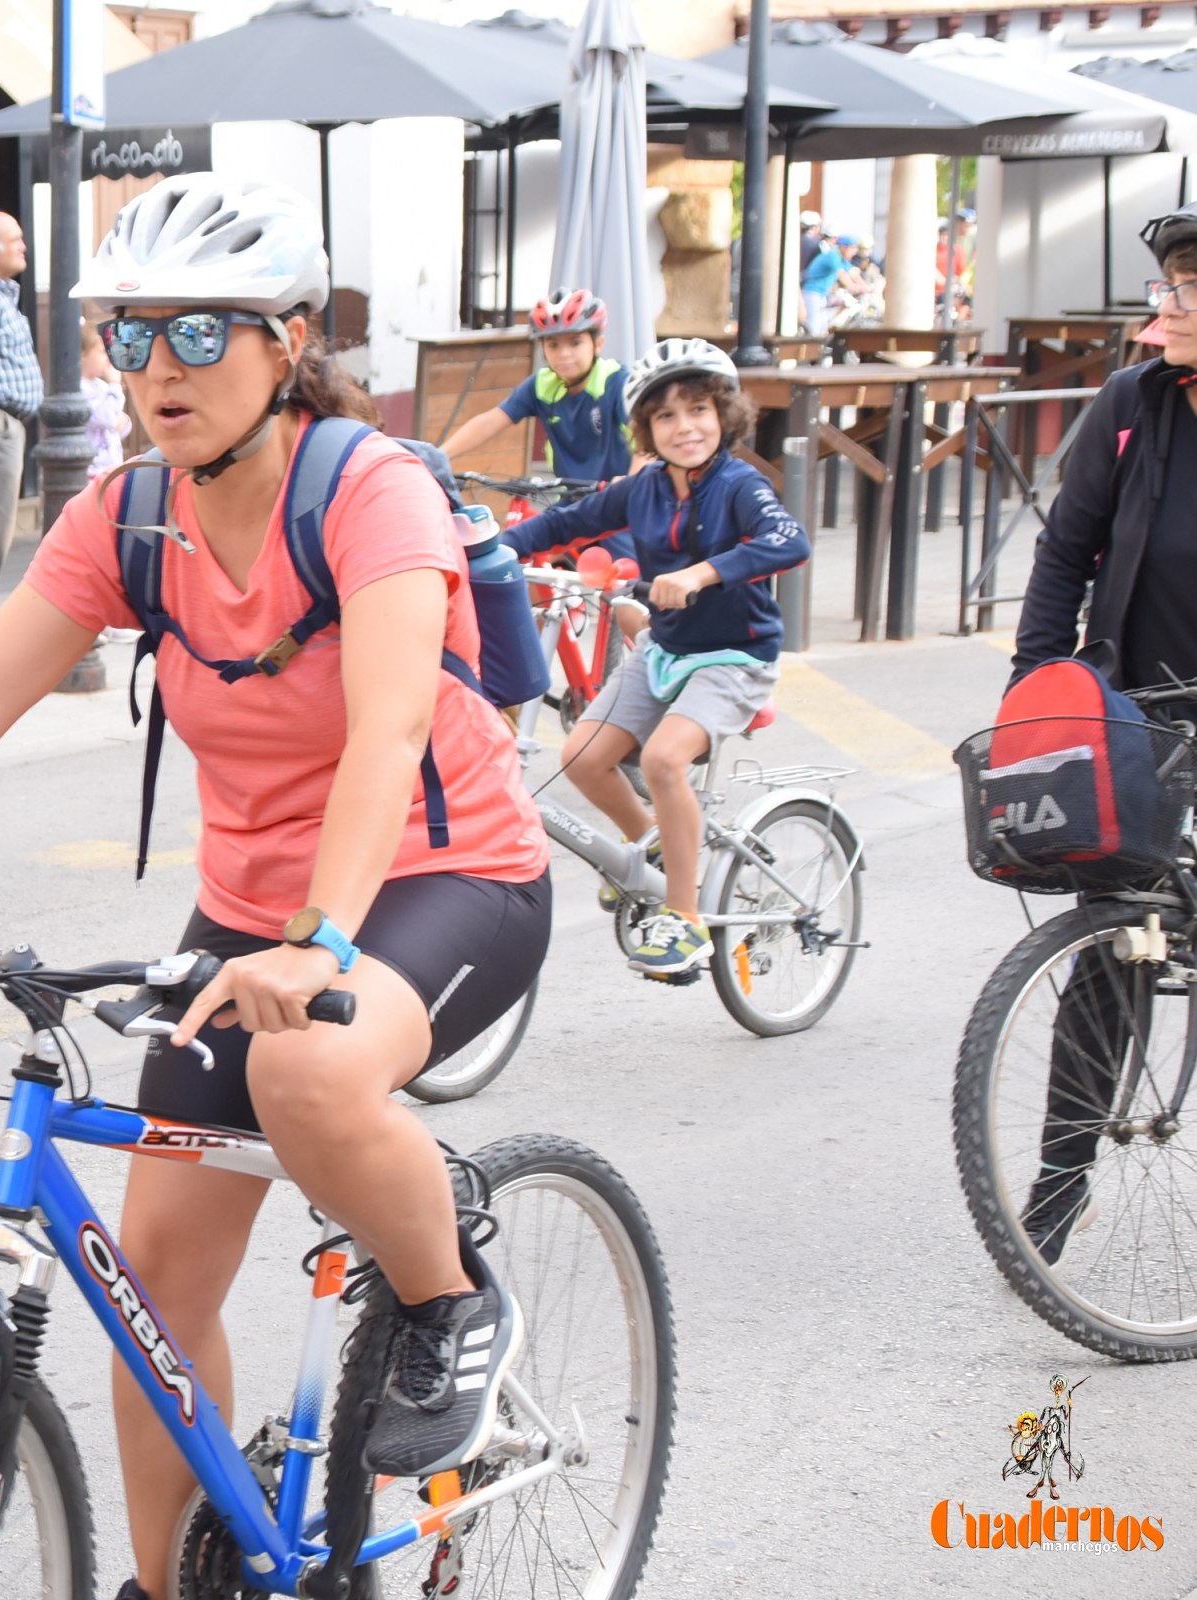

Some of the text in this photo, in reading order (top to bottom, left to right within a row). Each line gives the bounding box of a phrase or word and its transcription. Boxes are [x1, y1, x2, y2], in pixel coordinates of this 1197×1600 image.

[982, 129, 1145, 153] CERVEZAS ALHAMBRA
[988, 794, 1068, 836] FILA
[81, 1226, 195, 1422] ORBEA
